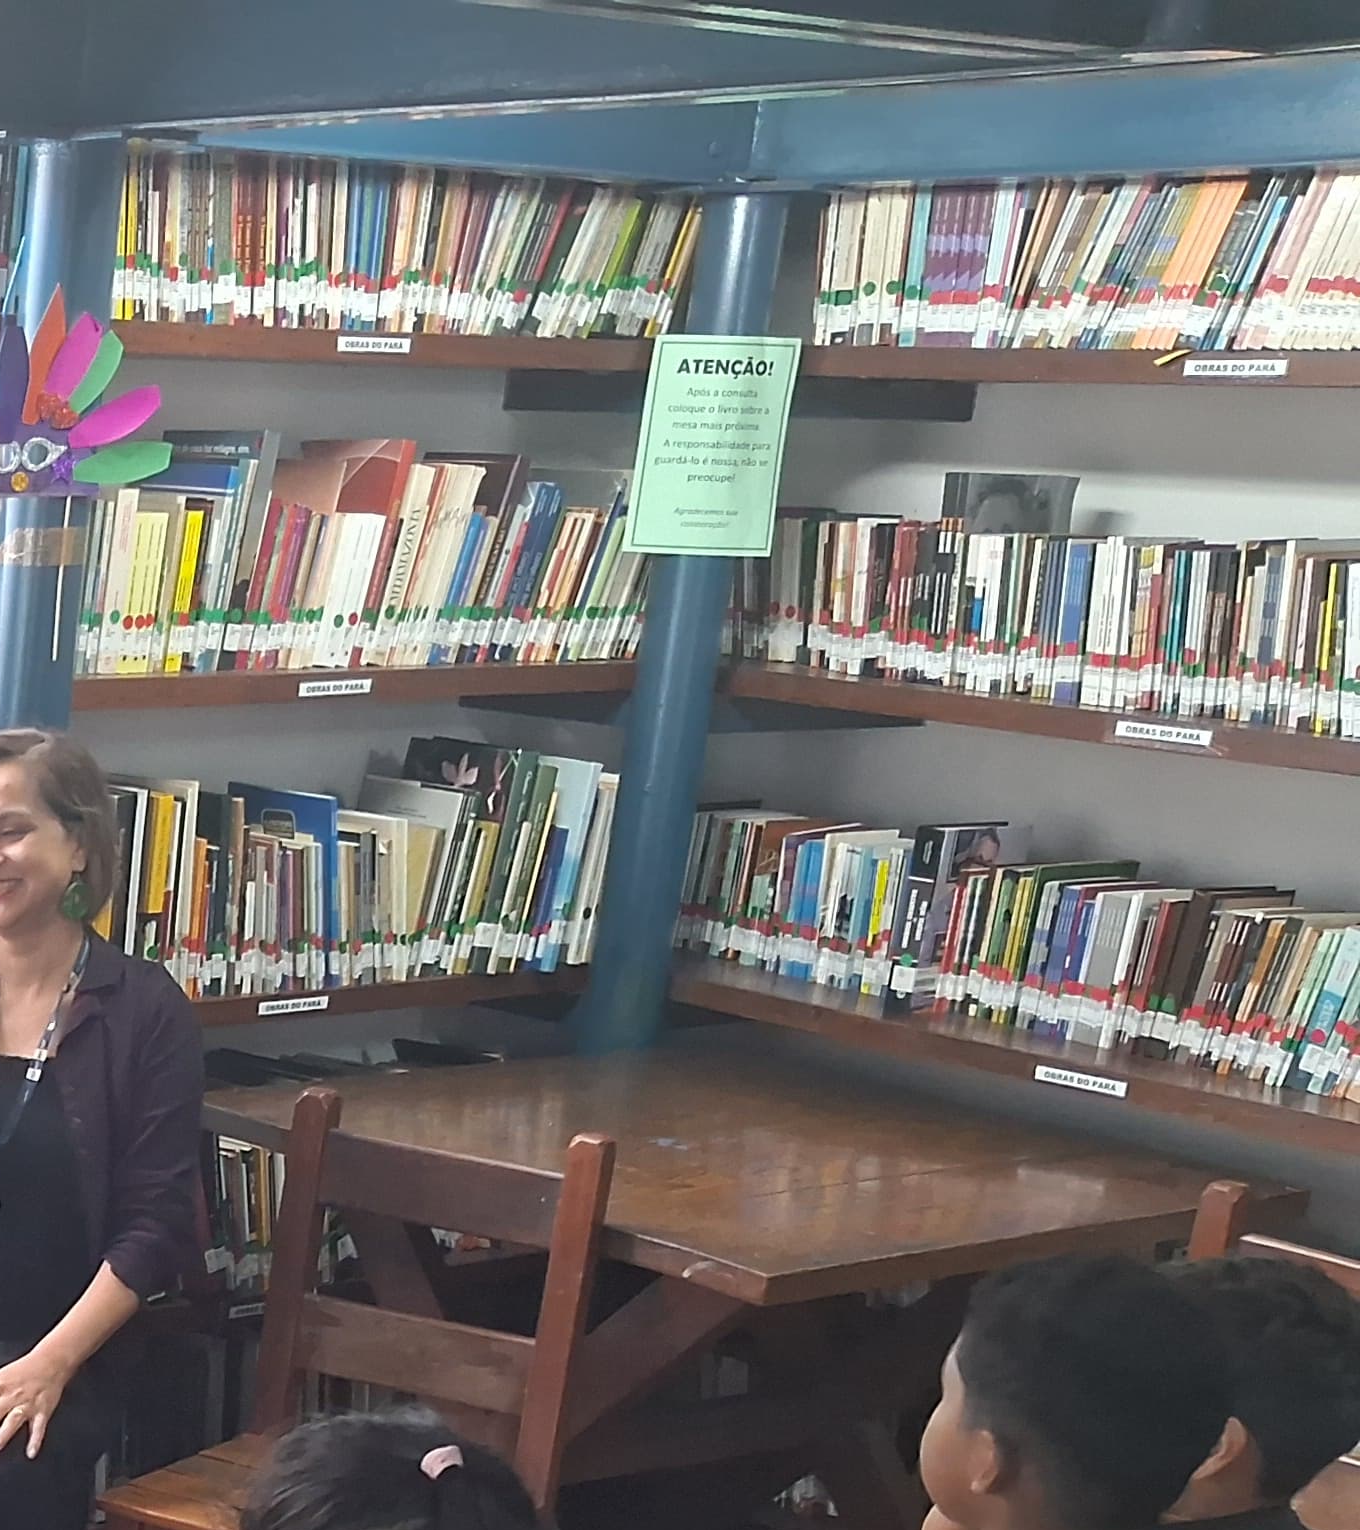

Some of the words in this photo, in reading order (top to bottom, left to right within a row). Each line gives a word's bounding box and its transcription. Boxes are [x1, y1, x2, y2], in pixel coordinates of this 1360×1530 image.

[676, 356, 774, 380] ATENÇÃO!
[1194, 364, 1228, 372] OBRAS
[1231, 364, 1246, 372] DO
[686, 387, 710, 398] Após
[722, 387, 758, 398] consulta
[668, 404, 706, 416] coloque
[708, 406, 714, 414] o
[718, 404, 738, 414] livro
[740, 405, 762, 415] sobre
[764, 407, 770, 415] a
[672, 421, 698, 430] mesa
[700, 420, 722, 430] mais
[663, 439, 670, 448] A
[673, 440, 750, 452] responsabilidade
[752, 442, 771, 452] para
[654, 455, 700, 466] guardá-lo
[702, 456, 708, 465] é
[740, 456, 756, 466] não
[759, 459, 768, 467] se
[686, 472, 736, 484] preocupe!
[1125, 725, 1158, 736] OBRAS
[1160, 730, 1174, 738] DO
[1044, 1070, 1075, 1083] OBRAS
[1077, 1077, 1090, 1086] DO
